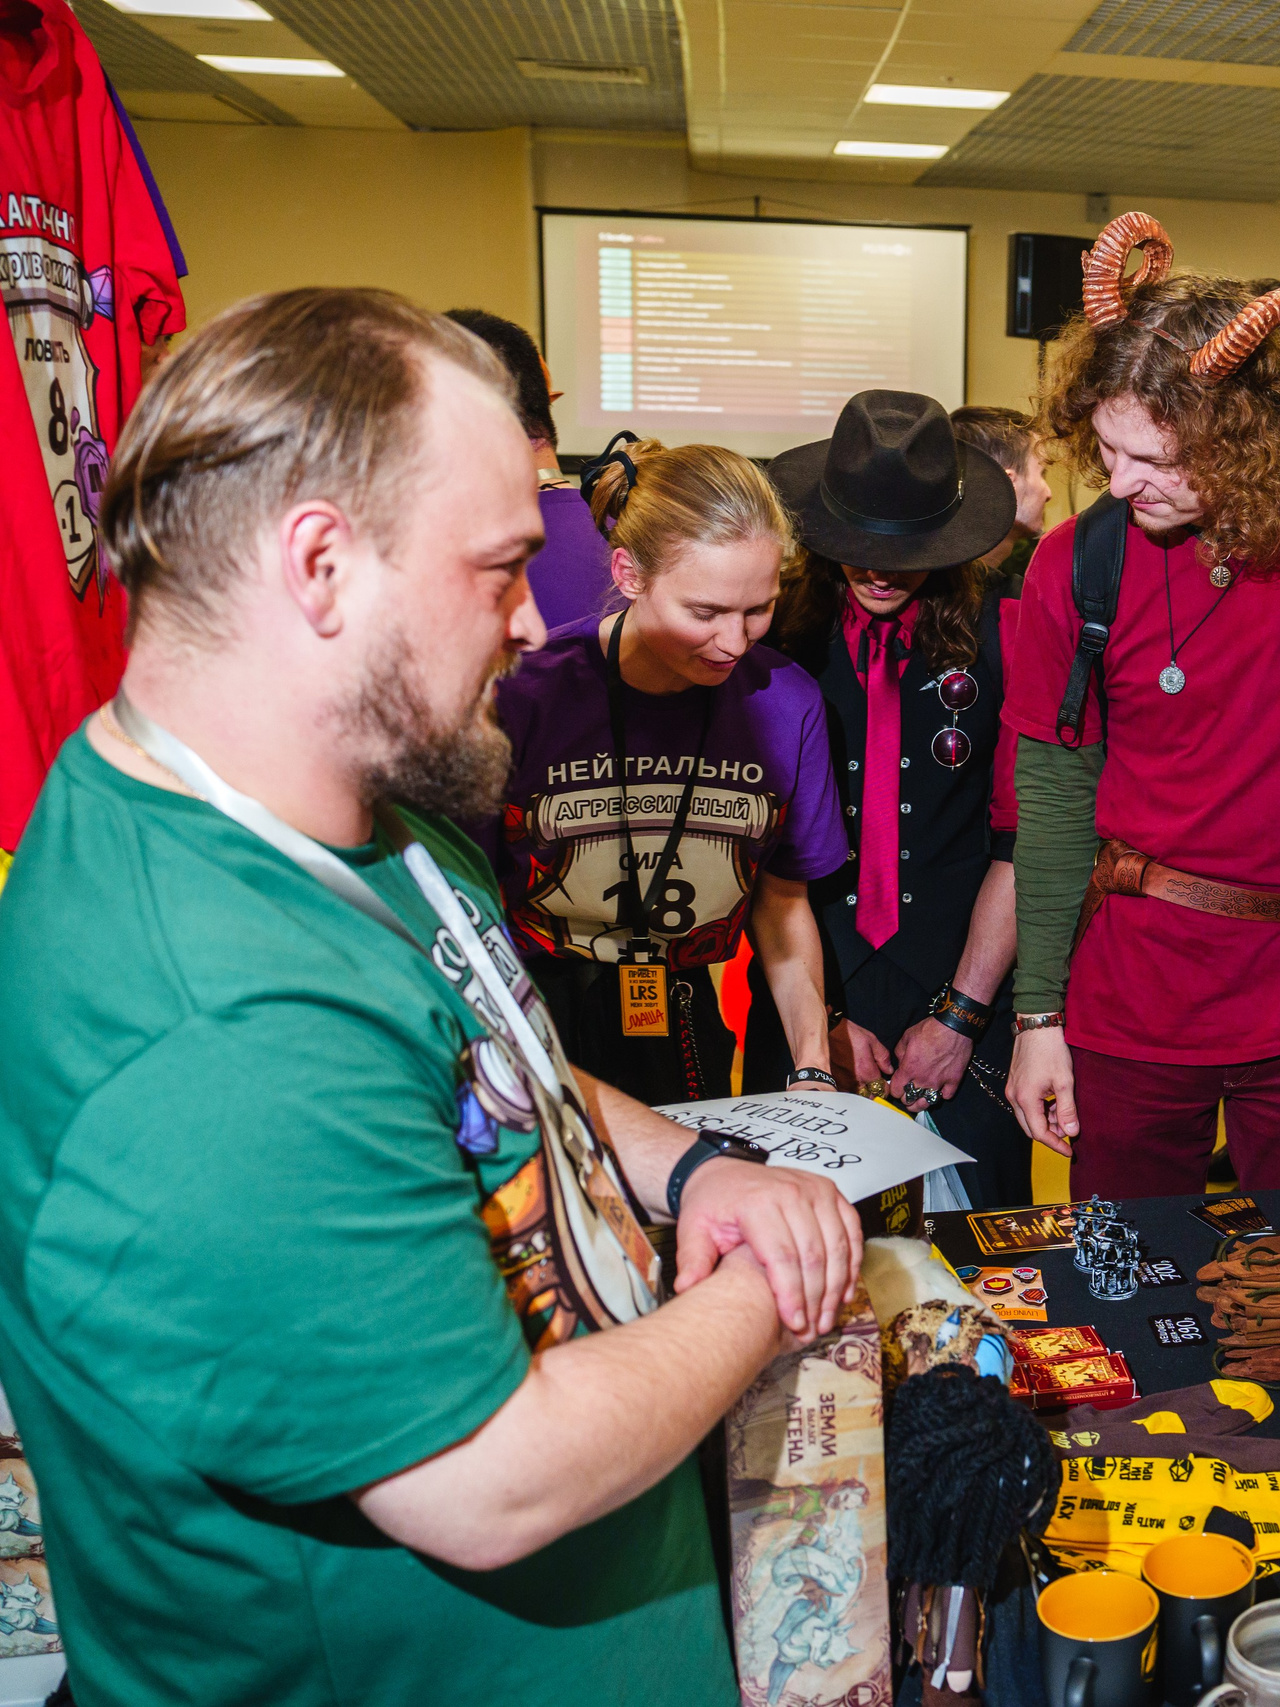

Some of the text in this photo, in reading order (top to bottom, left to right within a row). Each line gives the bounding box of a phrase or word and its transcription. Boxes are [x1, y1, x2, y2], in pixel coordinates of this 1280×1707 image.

[603, 878, 697, 934] 18
[630, 985, 658, 1000] LRS
[818, 1392, 838, 1458] ЗЕМЛИ
[1122, 1502, 1138, 1526] ВОЛК
[1252, 1521, 1280, 1534] TUDIO
